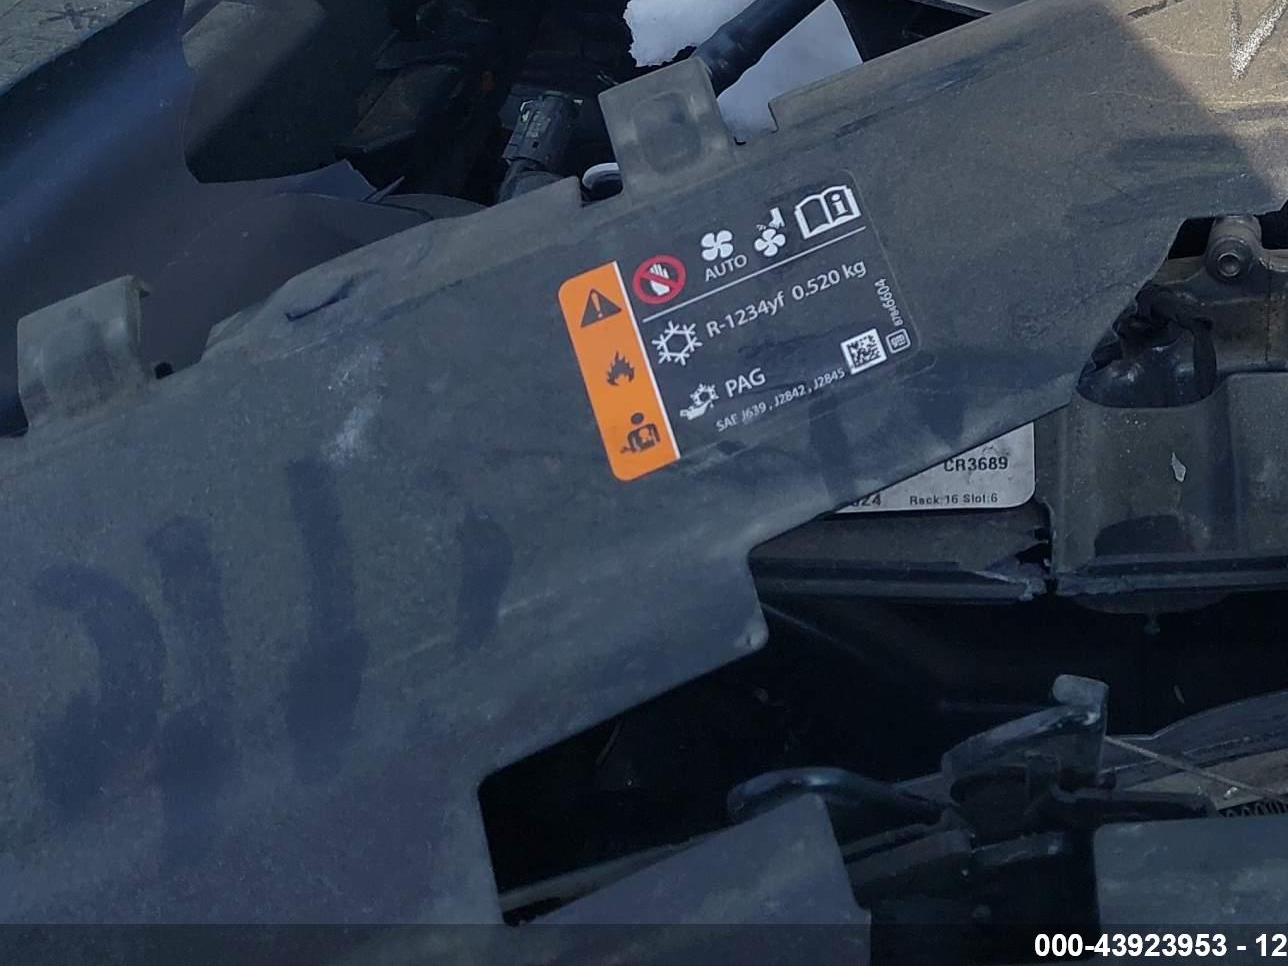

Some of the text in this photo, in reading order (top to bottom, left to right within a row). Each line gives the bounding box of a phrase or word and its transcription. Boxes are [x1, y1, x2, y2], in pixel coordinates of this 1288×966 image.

[705, 254, 747, 282] AUTO
[706, 261, 867, 337] R-1234yf 0.520 kg
[725, 368, 766, 397] PAG
[944, 456, 1008, 472] CR3689
